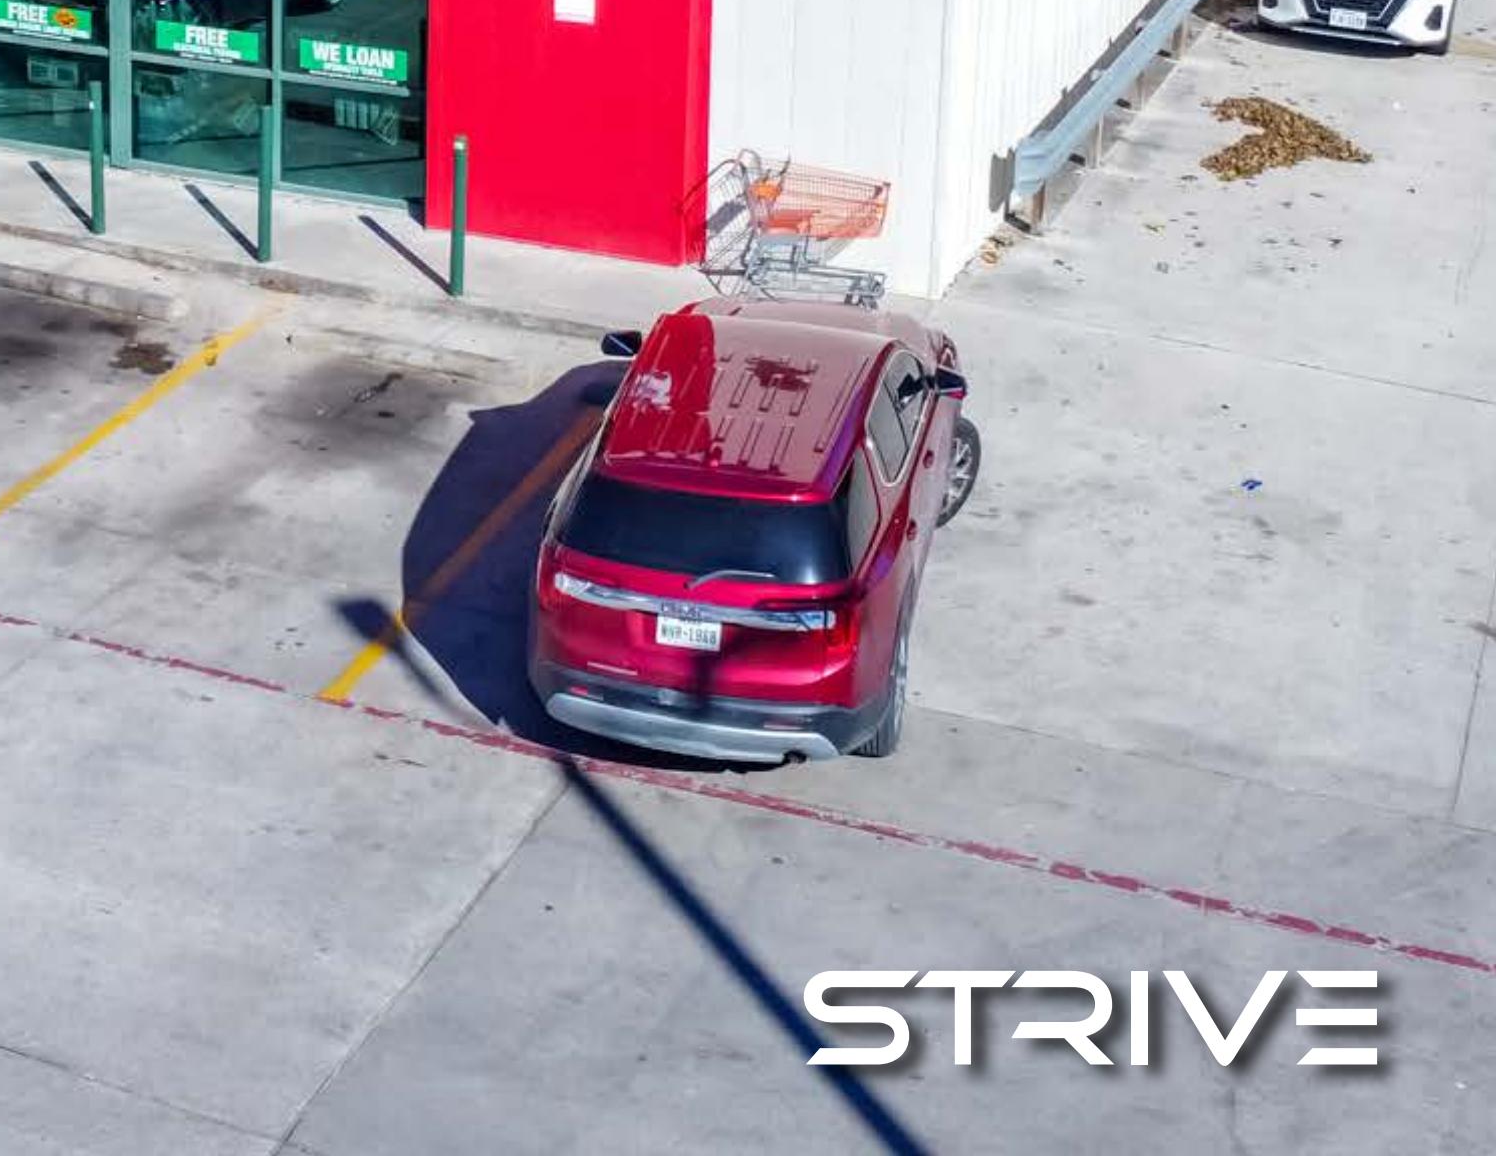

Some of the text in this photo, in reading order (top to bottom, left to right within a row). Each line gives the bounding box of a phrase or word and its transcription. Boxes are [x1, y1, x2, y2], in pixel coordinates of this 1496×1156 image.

[8, 1, 48, 24] FREE
[185, 24, 229, 48] FREE
[312, 40, 395, 69] WE LOAN
